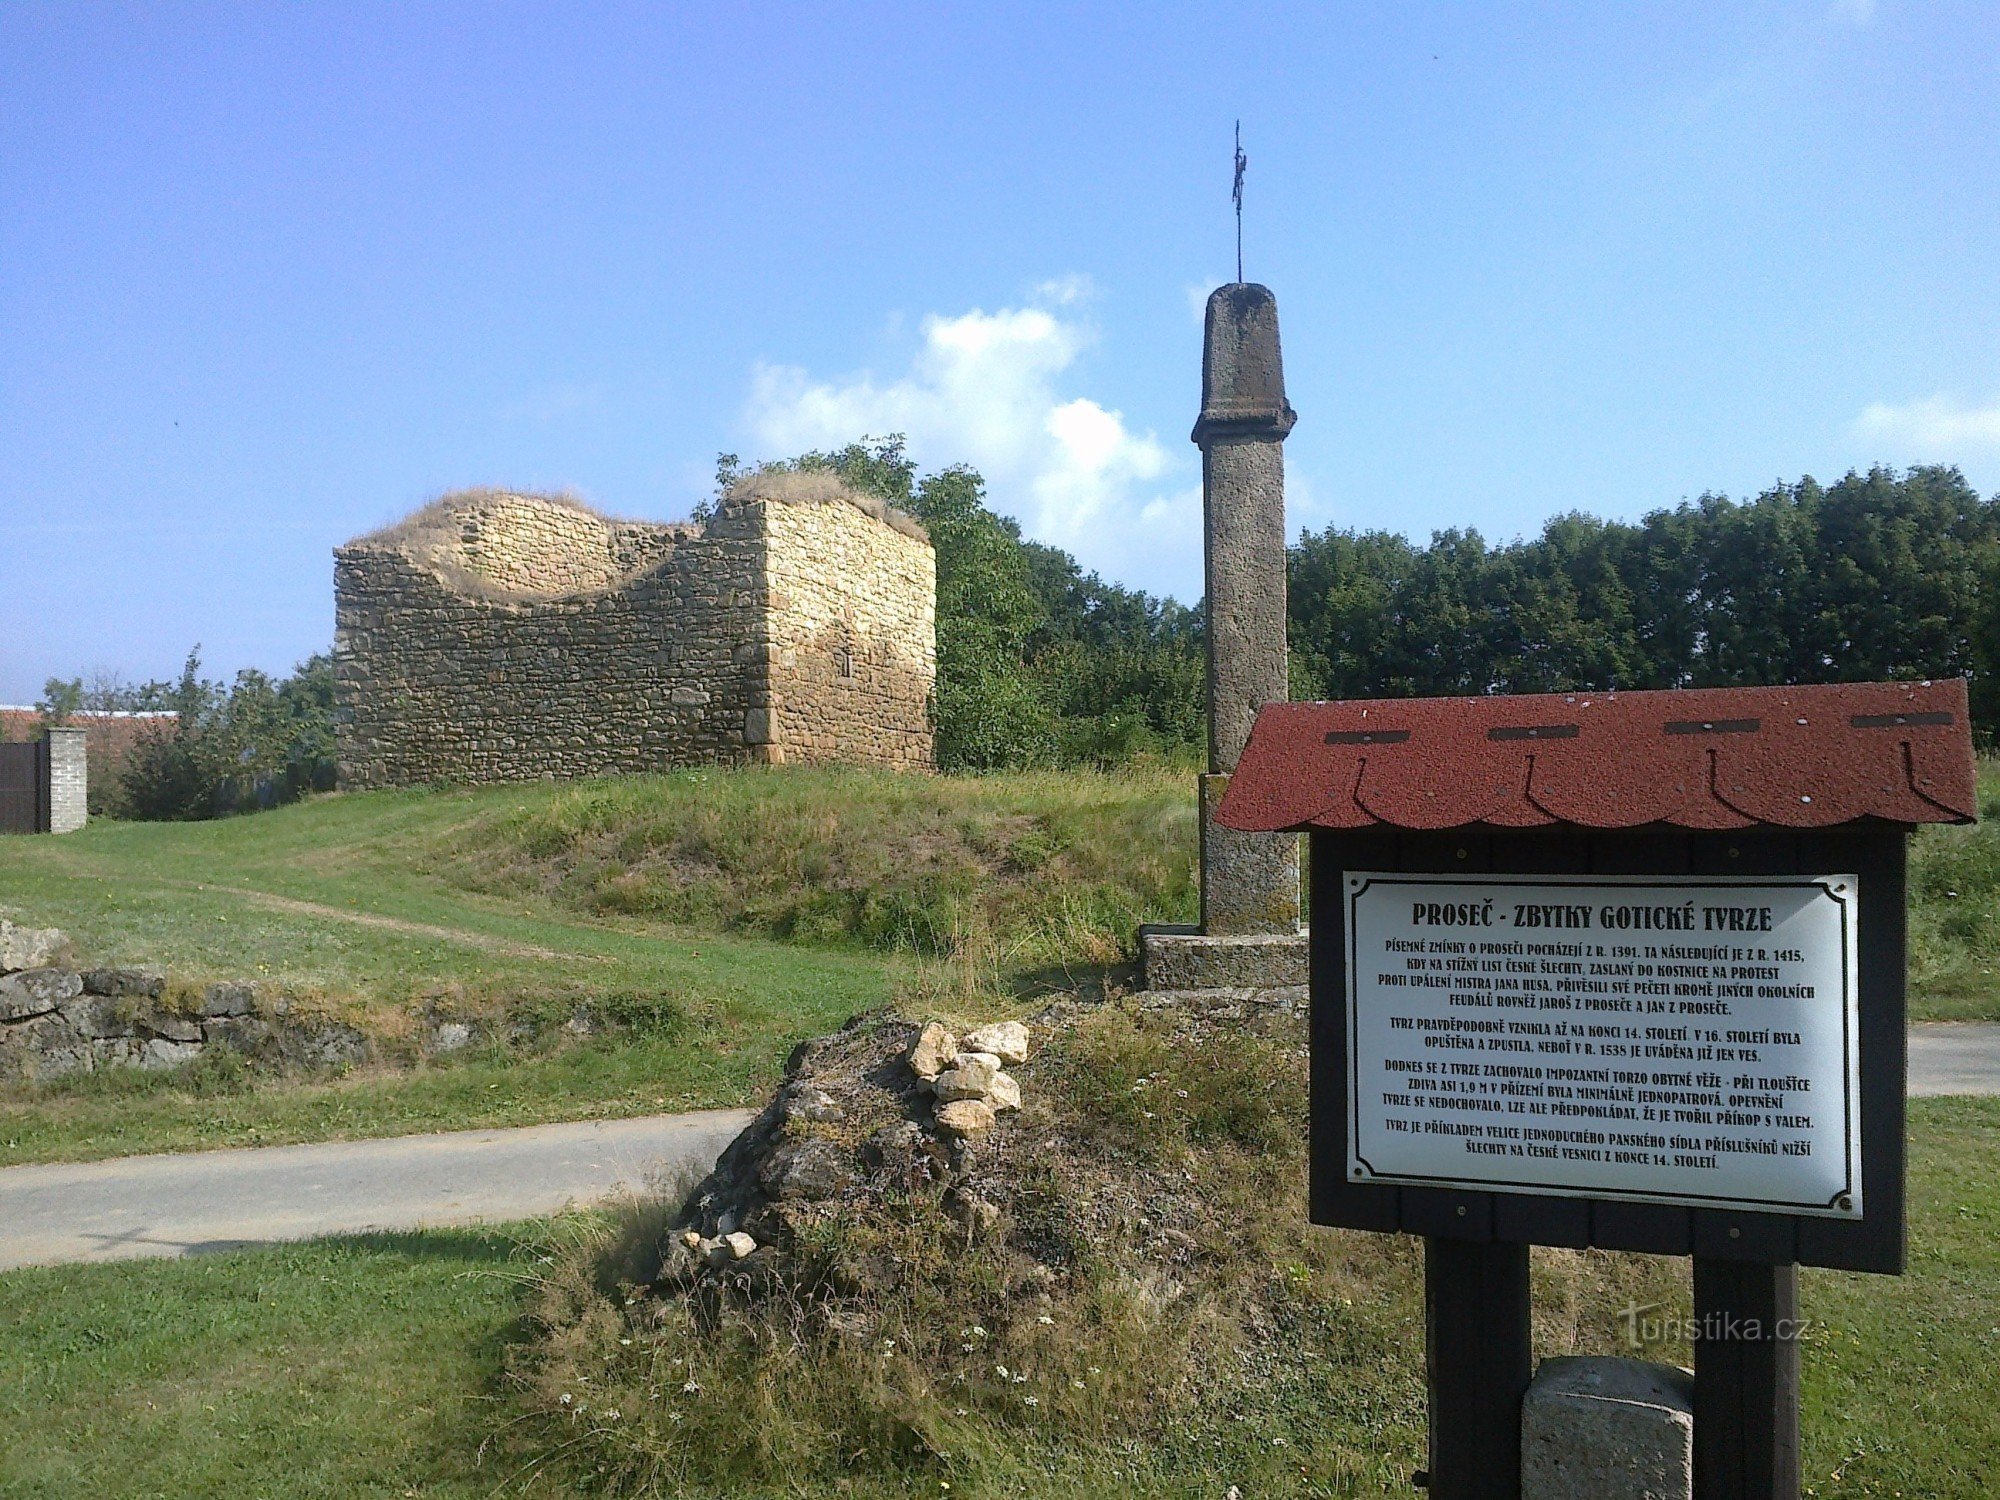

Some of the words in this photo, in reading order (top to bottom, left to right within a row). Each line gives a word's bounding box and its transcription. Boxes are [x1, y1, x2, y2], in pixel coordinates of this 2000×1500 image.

[1412, 898, 1494, 927] PROSEČ
[1513, 905, 1593, 928] ZBYTKY
[1600, 901, 1695, 930] GOTICKÉ
[1703, 907, 1772, 932] TVRZE
[1385, 937, 1426, 954] PÍSEMNÉ
[1429, 938, 1466, 954] ZMÍNKY
[1469, 942, 1476, 954] O
[1479, 940, 1523, 955] PROSEČI
[1527, 941, 1582, 957] POCHÁZEJÍ
[1586, 945, 1593, 957] Z
[1596, 945, 1607, 957] R.
[1611, 946, 1641, 958] 1391.
[1644, 946, 1657, 959] TA
[1661, 944, 1728, 961] NÁSLEDUJÍCÍ
[1731, 947, 1743, 961] JE
[1747, 948, 1754, 961] Z
[1758, 948, 1770, 962] R.
[1773, 948, 1805, 963] 1415,
[1407, 957, 1427, 972] KDY
[1429, 958, 1443, 971] NA
[1446, 956, 1478, 972] STÍŽNÝ
[1481, 959, 1502, 972] LIST
[1506, 957, 1537, 974] ČESKÉ
[1589, 961, 1634, 976] ZASLANÝ
[1637, 964, 1653, 977] DO
[1657, 964, 1709, 979] KOSTNICE
[1713, 965, 1727, 979] NA
[1731, 966, 1780, 980] PROTEST
[1378, 974, 1407, 987] PROTI
[1410, 972, 1451, 988] UPÁLENÍ
[1454, 975, 1491, 990] MISTRA
[1494, 977, 1519, 991] JANA
[1556, 977, 1608, 993] PŘIVĚSILI
[1612, 979, 1630, 994] SVÉ
[1634, 978, 1670, 995] PEČETI
[1674, 980, 1714, 997] KROMĚ
[1717, 981, 1753, 998] JINÝCH
[1757, 982, 1815, 999] OKOLNÍCH
[1449, 991, 1493, 1007] FEUDÁLŮ
[1496, 993, 1537, 1009] ROVNĚŽ
[1539, 995, 1572, 1010] JAROŠ
[1575, 997, 1581, 1010] Z
[1585, 996, 1632, 1012] PROSEČE
[1636, 1000, 1643, 1013] A
[1646, 1000, 1665, 1014] JAN
[1669, 1000, 1676, 1014] Z
[1679, 999, 1732, 1016] PROSEČE.
[1390, 1016, 1414, 1030] TVRZ
[1417, 1017, 1505, 1034] PRAVDĚPODOBNĚ
[1508, 1021, 1551, 1036] VZNIKLA
[1554, 1020, 1568, 1036] AŽ
[1571, 1024, 1585, 1037] NA
[1588, 1025, 1621, 1039] KONCI
[1625, 1027, 1642, 1040] 14.
[1694, 1029, 1702, 1042] V
[1704, 1029, 1722, 1043] 16.
[1726, 1028, 1770, 1044] STOLETÍ
[1773, 1031, 1801, 1045] BYLA
[1424, 1033, 1474, 1050] OPUŠTĚNA
[1477, 1037, 1485, 1050] A
[1575, 1042, 1582, 1055] V
[1585, 1042, 1596, 1055] R.
[1600, 1043, 1627, 1057] 1538
[1630, 1044, 1641, 1058] JE
[1644, 1042, 1694, 1060] UVÁDĚNA
[1697, 1044, 1714, 1061] JIŽ
[1716, 1047, 1734, 1061] JEN
[1385, 1059, 1423, 1073] DODNES
[1426, 1061, 1438, 1074] SE
[1441, 1062, 1447, 1075] Z
[1450, 1061, 1480, 1076] TVRZE
[1483, 1064, 1542, 1079] ZACHOVALO
[1546, 1067, 1609, 1082] IMPOZANTNÍ
[1613, 1071, 1648, 1084] TORZO
[1652, 1071, 1692, 1087] OBYTNÉ
[1696, 1071, 1721, 1088] VĚŽE
[1733, 1073, 1754, 1090] PŘI
[1758, 1075, 1811, 1092] TLOUŠŤCE
[1408, 1077, 1437, 1092] ZDIVA
[1440, 1079, 1457, 1092] ASI
[1459, 1080, 1476, 1094] 1,9
[1479, 1081, 1487, 1094] M
[1491, 1082, 1497, 1094] V
[1501, 1080, 1544, 1097] PŘÍZEMÍ
[1547, 1085, 1572, 1099] BYLA
[1576, 1085, 1634, 1102] MINIMÁLNĚ
[1728, 1092, 1784, 1110] OPEVNĚNÍ
[1382, 1092, 1411, 1107] TVRZE
[1414, 1095, 1425, 1108] SE
[1428, 1096, 1504, 1112] NEDOCHOVALO,
[1508, 1099, 1526, 1114] LZE
[1529, 1101, 1548, 1115] ALE
[1551, 1101, 1639, 1120] PŘEDPOKLÁDAT,
[1642, 1105, 1656, 1121] ŽE
[1659, 1107, 1671, 1122] JE
[1674, 1106, 1713, 1124] TVOŘIL
[1716, 1109, 1761, 1126] PŘÍKOP
[1764, 1113, 1771, 1127] S
[1775, 1114, 1814, 1129] VALEM.
[1385, 1118, 1409, 1132] TVRZ
[1410, 1121, 1421, 1134] JE
[1424, 1119, 1483, 1137] PŘÍKLADEM
[1486, 1125, 1520, 1140] VELICE
[1523, 1128, 1604, 1144] JEDNODUCHÉHO
[1609, 1130, 1666, 1148] PANSKÉHO
[1669, 1133, 1701, 1150] SÍDLA
[1705, 1136, 1778, 1154] PŘÍSLUŠNÍKŮ
[1782, 1139, 1811, 1157] NIŽŠÍ
[1465, 1138, 1507, 1155] ŠLECHTY
[1510, 1144, 1524, 1157] NA
[1527, 1142, 1559, 1159] ČESKÉ
[1562, 1147, 1601, 1162] VESNICI
[1604, 1150, 1611, 1162] Z
[1614, 1150, 1650, 1165] KONCE
[1653, 1153, 1670, 1167] 14.
